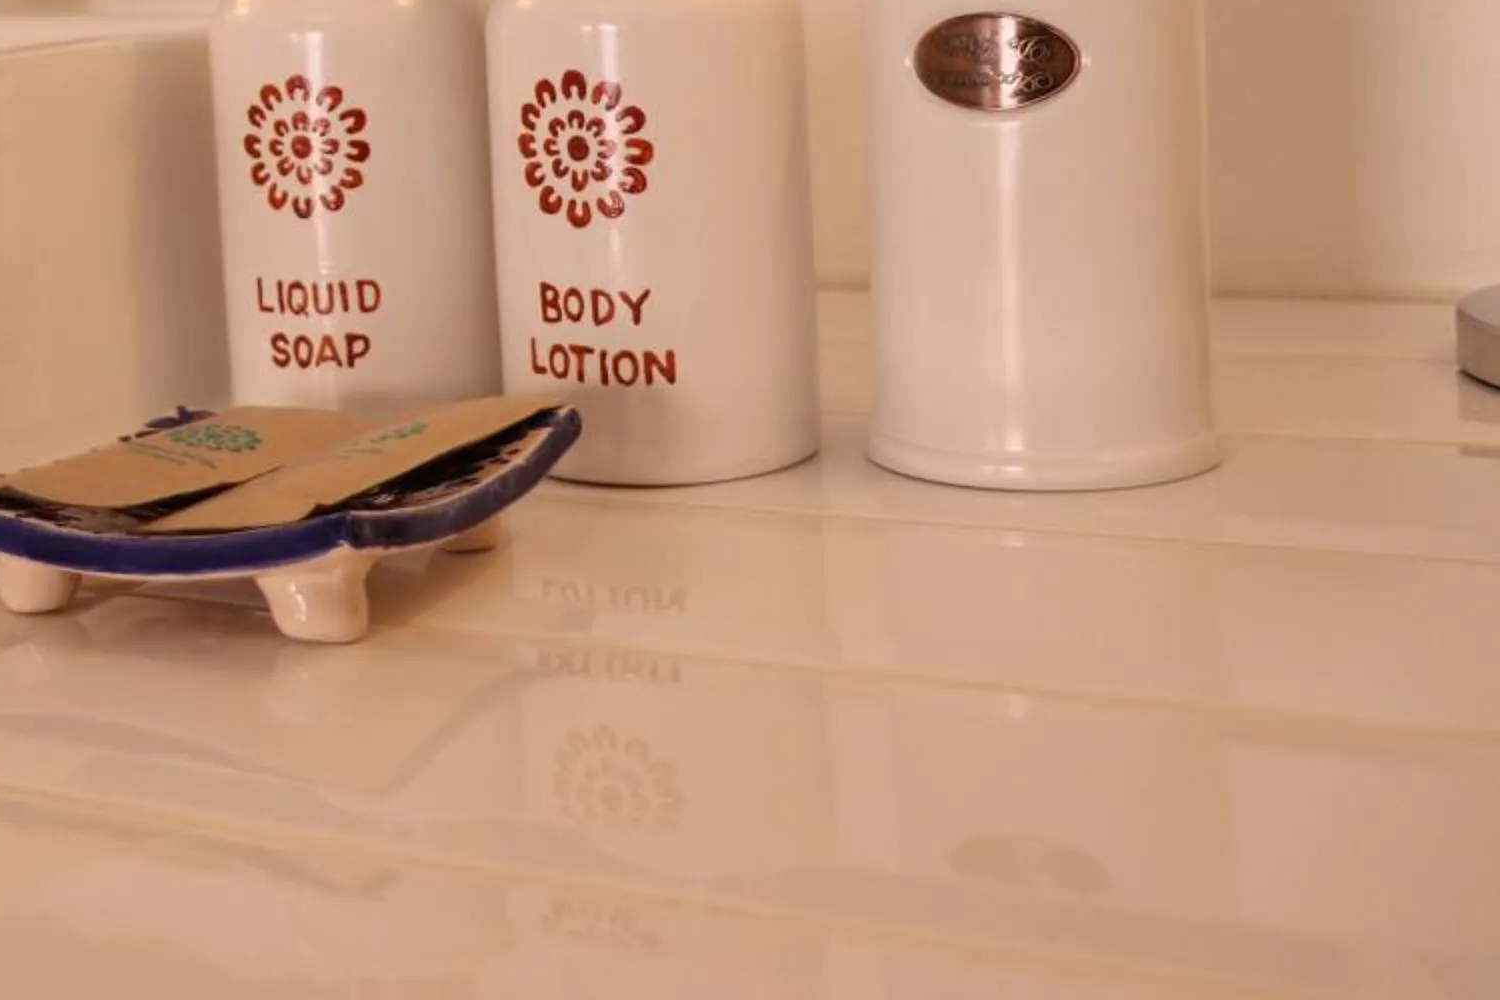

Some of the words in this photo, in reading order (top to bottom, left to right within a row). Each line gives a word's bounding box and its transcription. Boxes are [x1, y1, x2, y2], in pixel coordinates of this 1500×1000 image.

[257, 277, 382, 317] LIQUID
[539, 281, 651, 326] BODY
[269, 332, 371, 369] SOAP
[530, 337, 677, 386] LOTION
